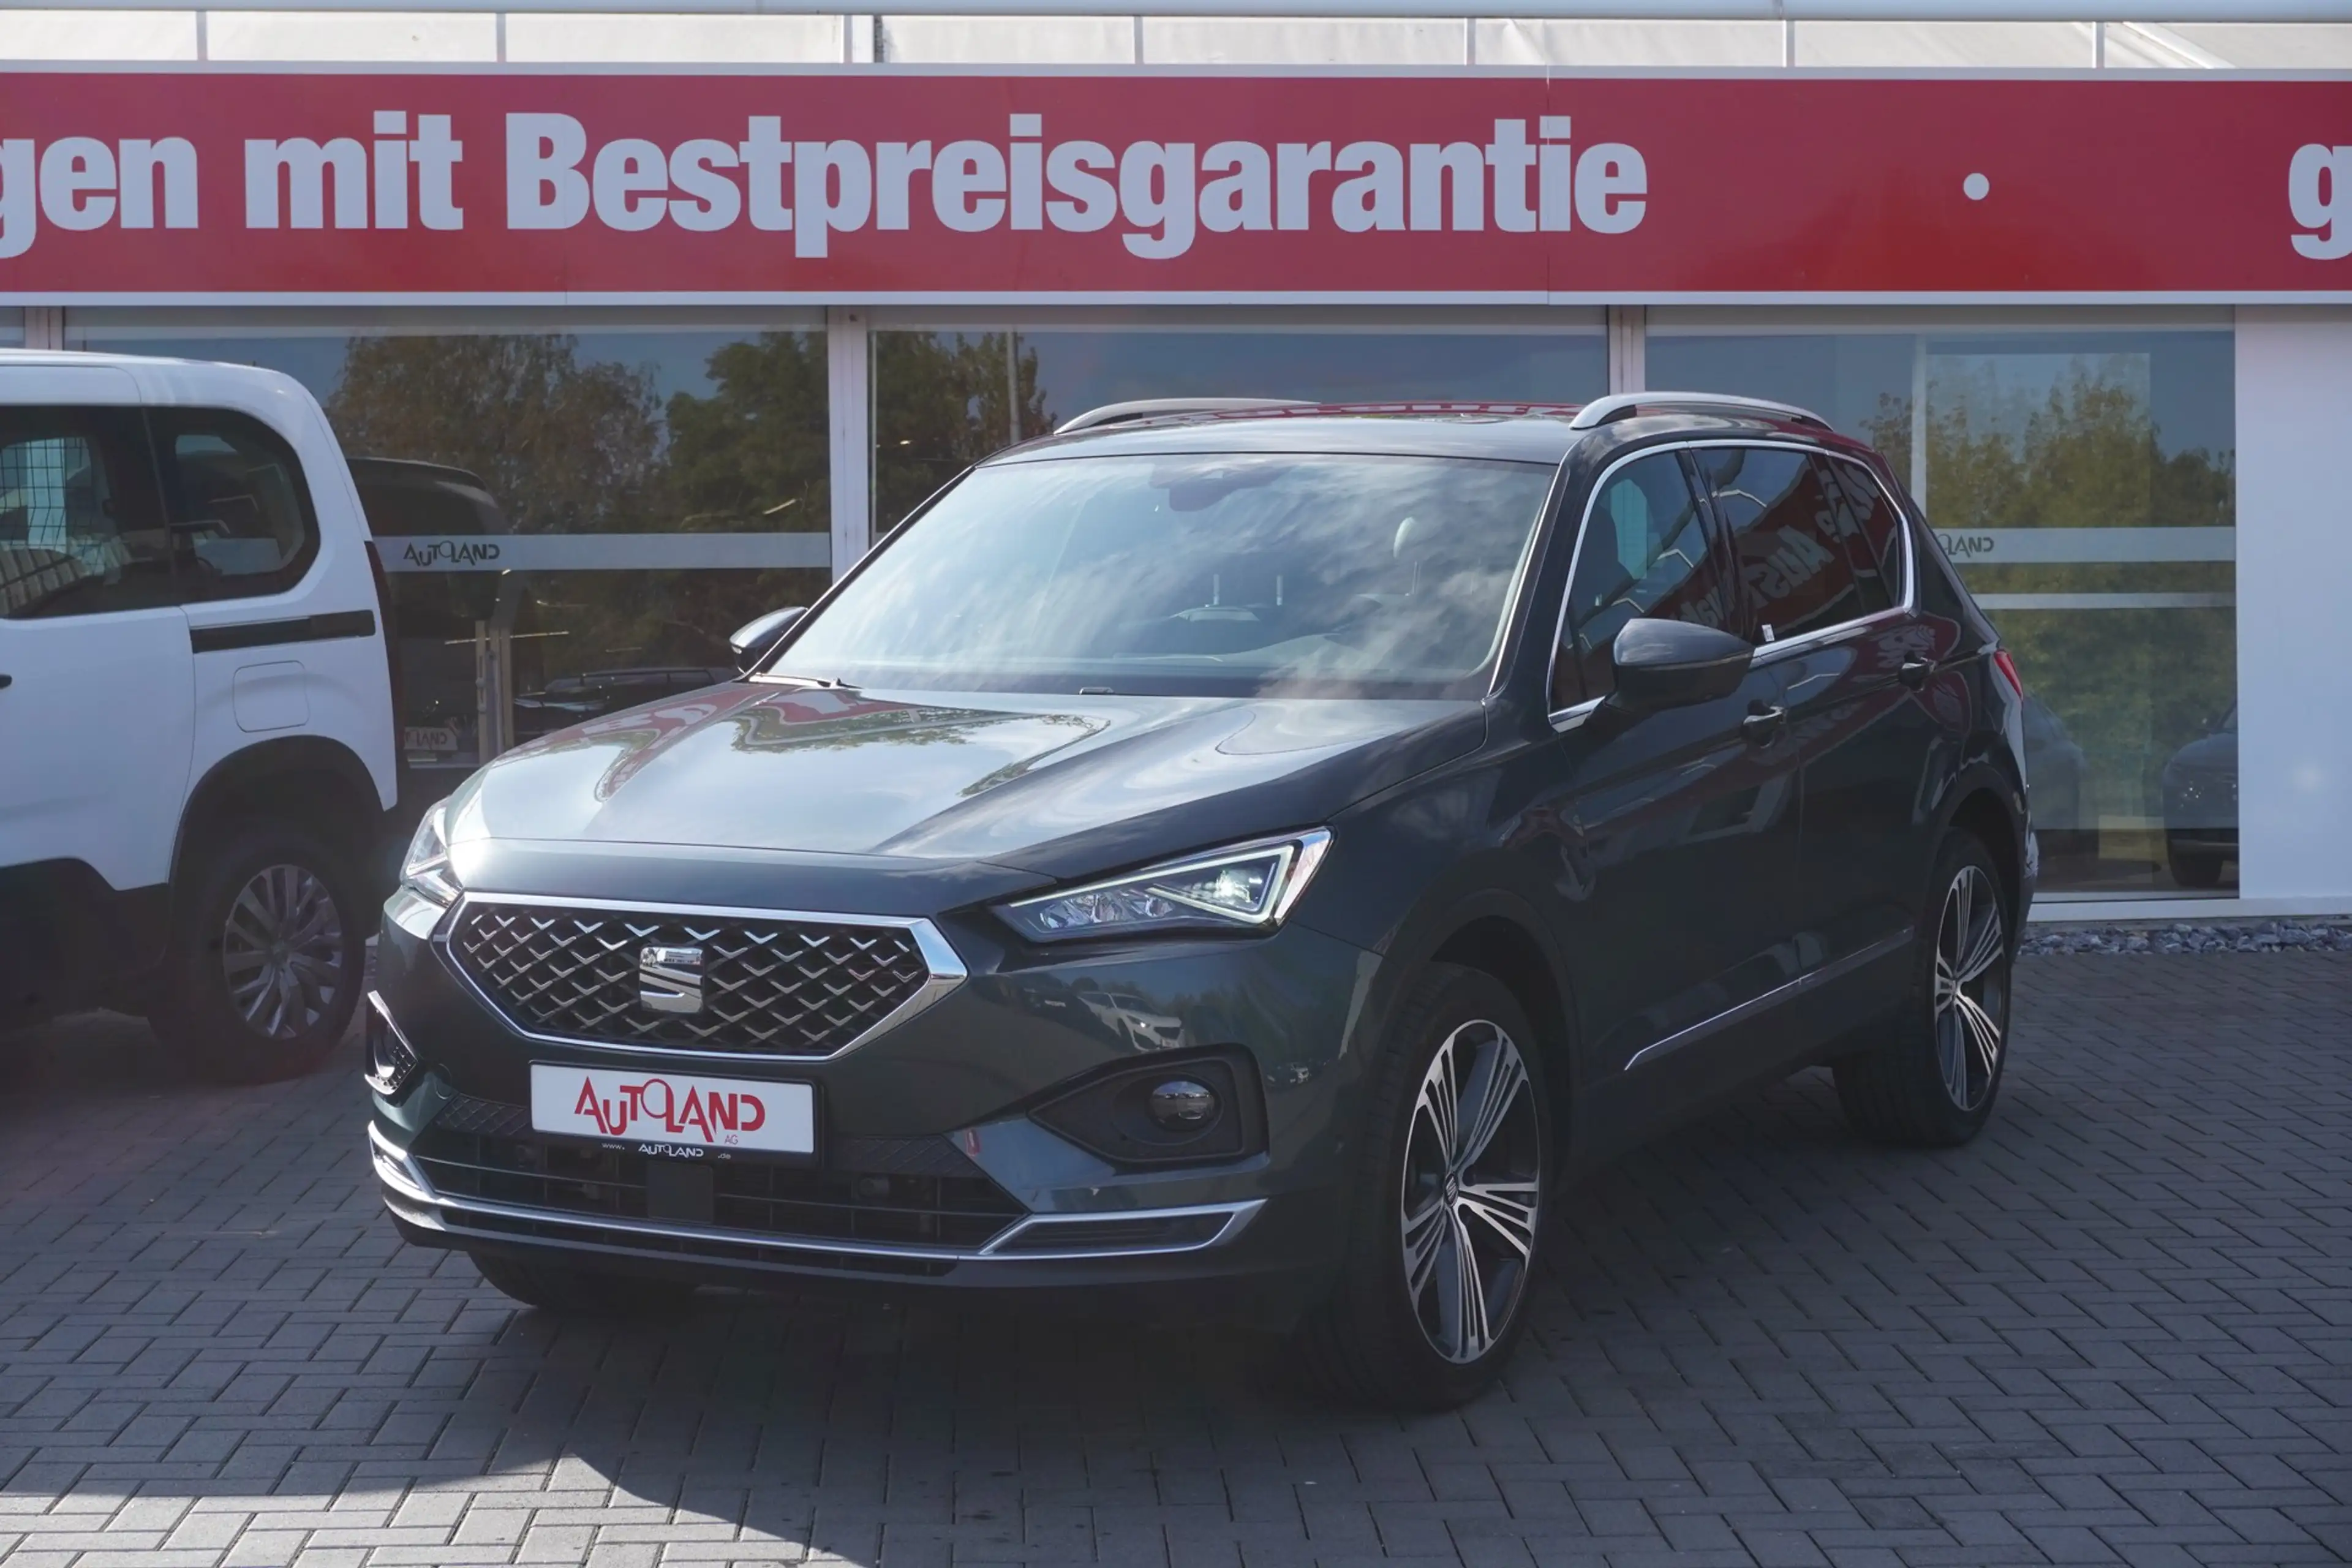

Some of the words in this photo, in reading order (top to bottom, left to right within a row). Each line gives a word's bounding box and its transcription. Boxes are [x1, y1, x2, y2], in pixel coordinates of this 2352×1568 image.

[245, 110, 464, 230] mit
[505, 112, 1648, 260] Bestpreisgarantie
[402, 540, 501, 567] AUTOLAND
[1937, 533, 1994, 558] OLAND
[574, 1076, 766, 1143] AUTOLAND
[638, 1143, 704, 1158] AUTOLAND
[724, 1134, 739, 1145] AG
